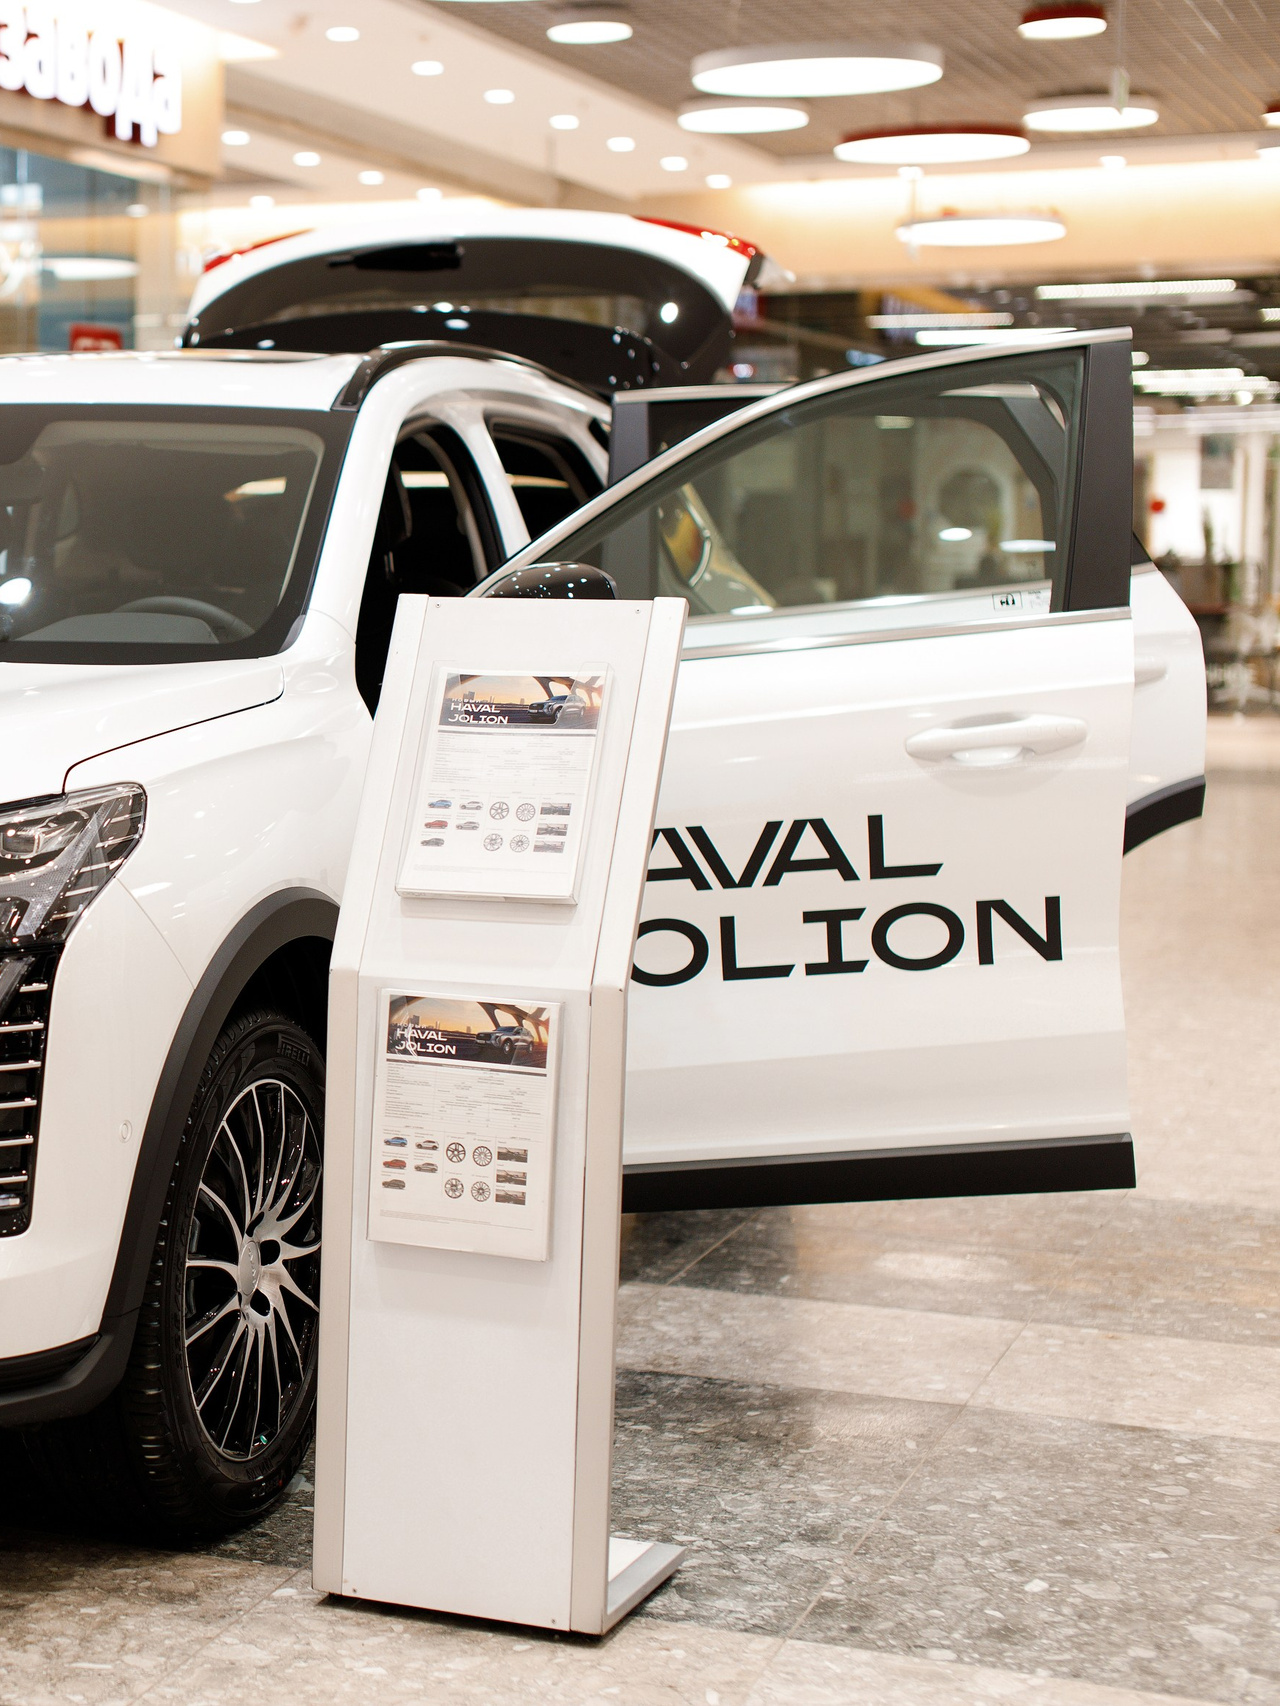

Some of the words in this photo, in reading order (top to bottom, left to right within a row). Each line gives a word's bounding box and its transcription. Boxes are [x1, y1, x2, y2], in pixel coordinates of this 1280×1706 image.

[450, 702, 501, 713] HAVAL
[448, 713, 509, 725] JOLION
[645, 814, 944, 891] AVAL
[631, 895, 1063, 987] OLION
[396, 1028, 448, 1041] HAVAL
[395, 1040, 457, 1055] JOLION
